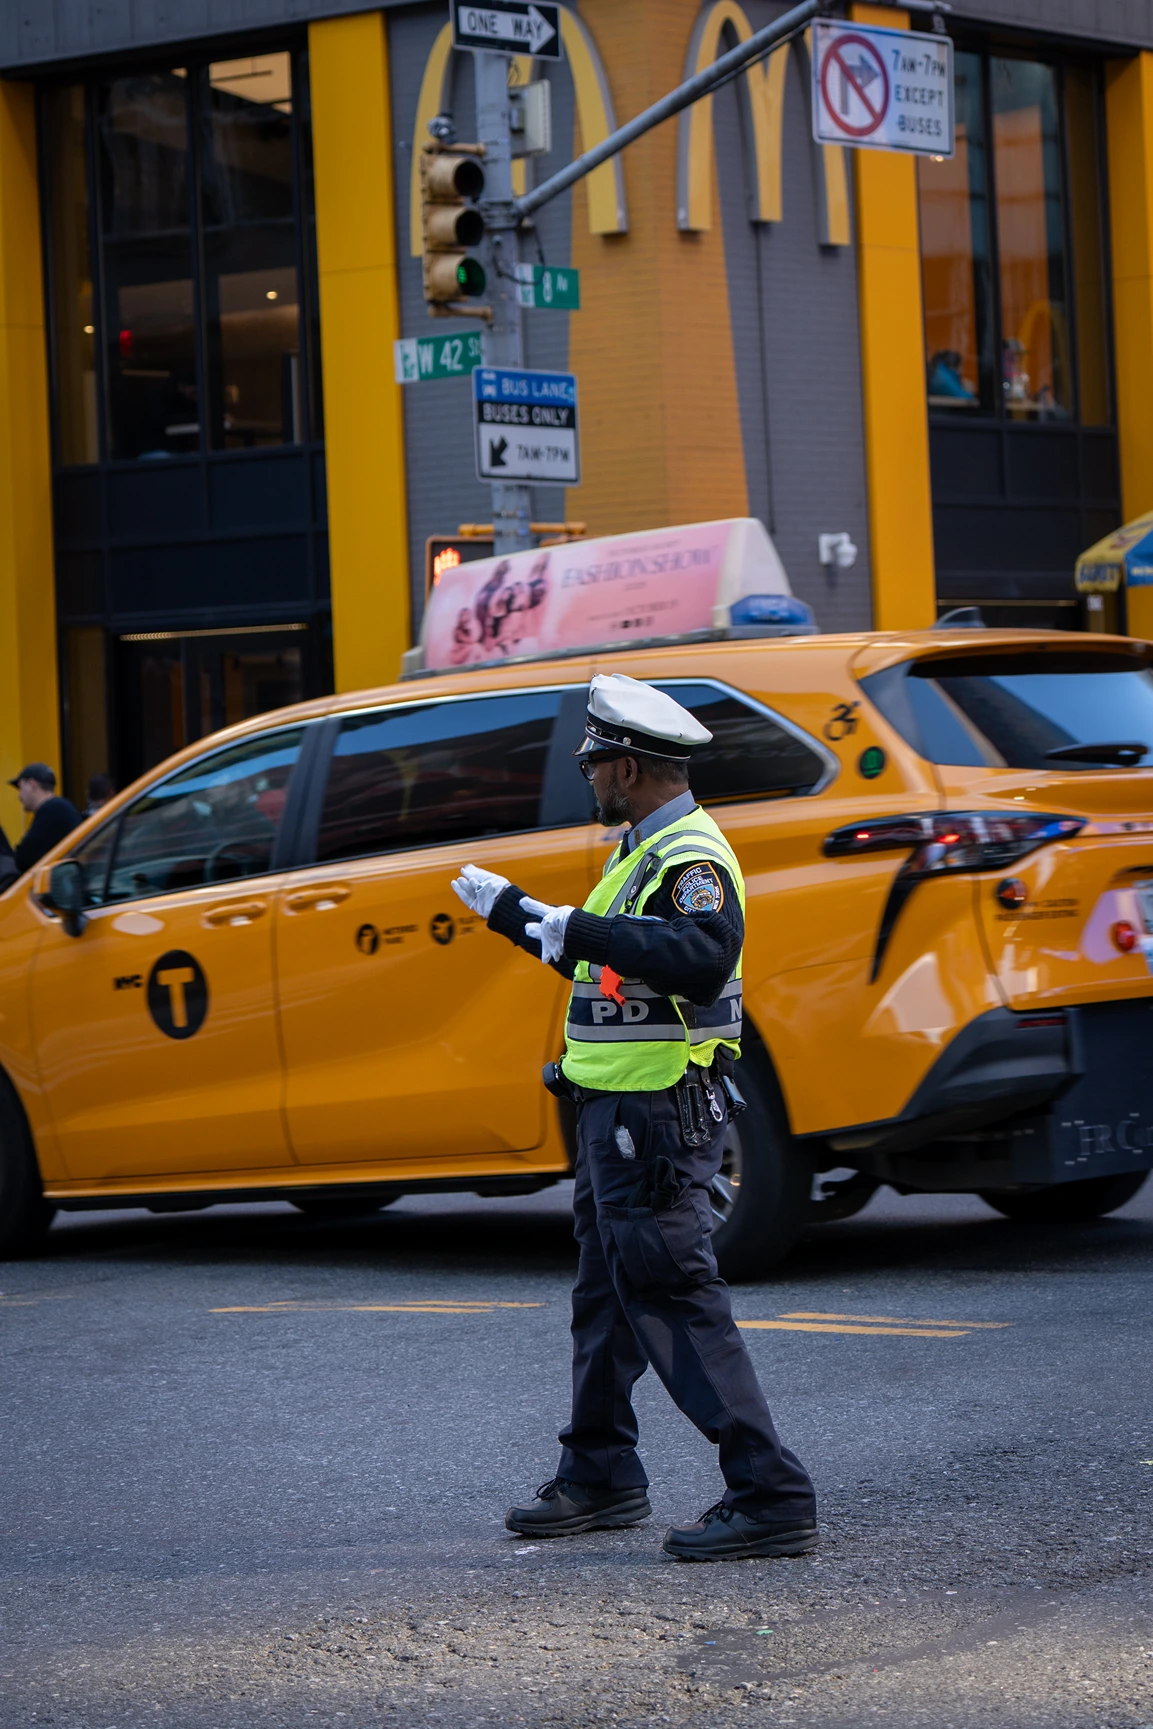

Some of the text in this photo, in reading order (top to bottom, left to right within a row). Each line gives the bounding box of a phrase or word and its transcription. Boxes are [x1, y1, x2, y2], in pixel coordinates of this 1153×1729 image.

[467, 11, 544, 39] ONE WAY
[894, 84, 945, 107] EXCEPT
[898, 114, 943, 137] BUSES
[542, 270, 553, 303] 8
[417, 341, 434, 374] W
[440, 338, 464, 371] 42
[502, 377, 528, 396] BUS
[482, 403, 570, 426] BUSES ONLY
[517, 444, 570, 463] 7AM-7PM
[677, 867, 702, 890] TRAFFIC
[682, 876, 703, 892] POLICE
[679, 878, 714, 904] DEPARTMENT
[113, 967, 195, 1029] NYC T
[591, 1000, 650, 1024] PD
